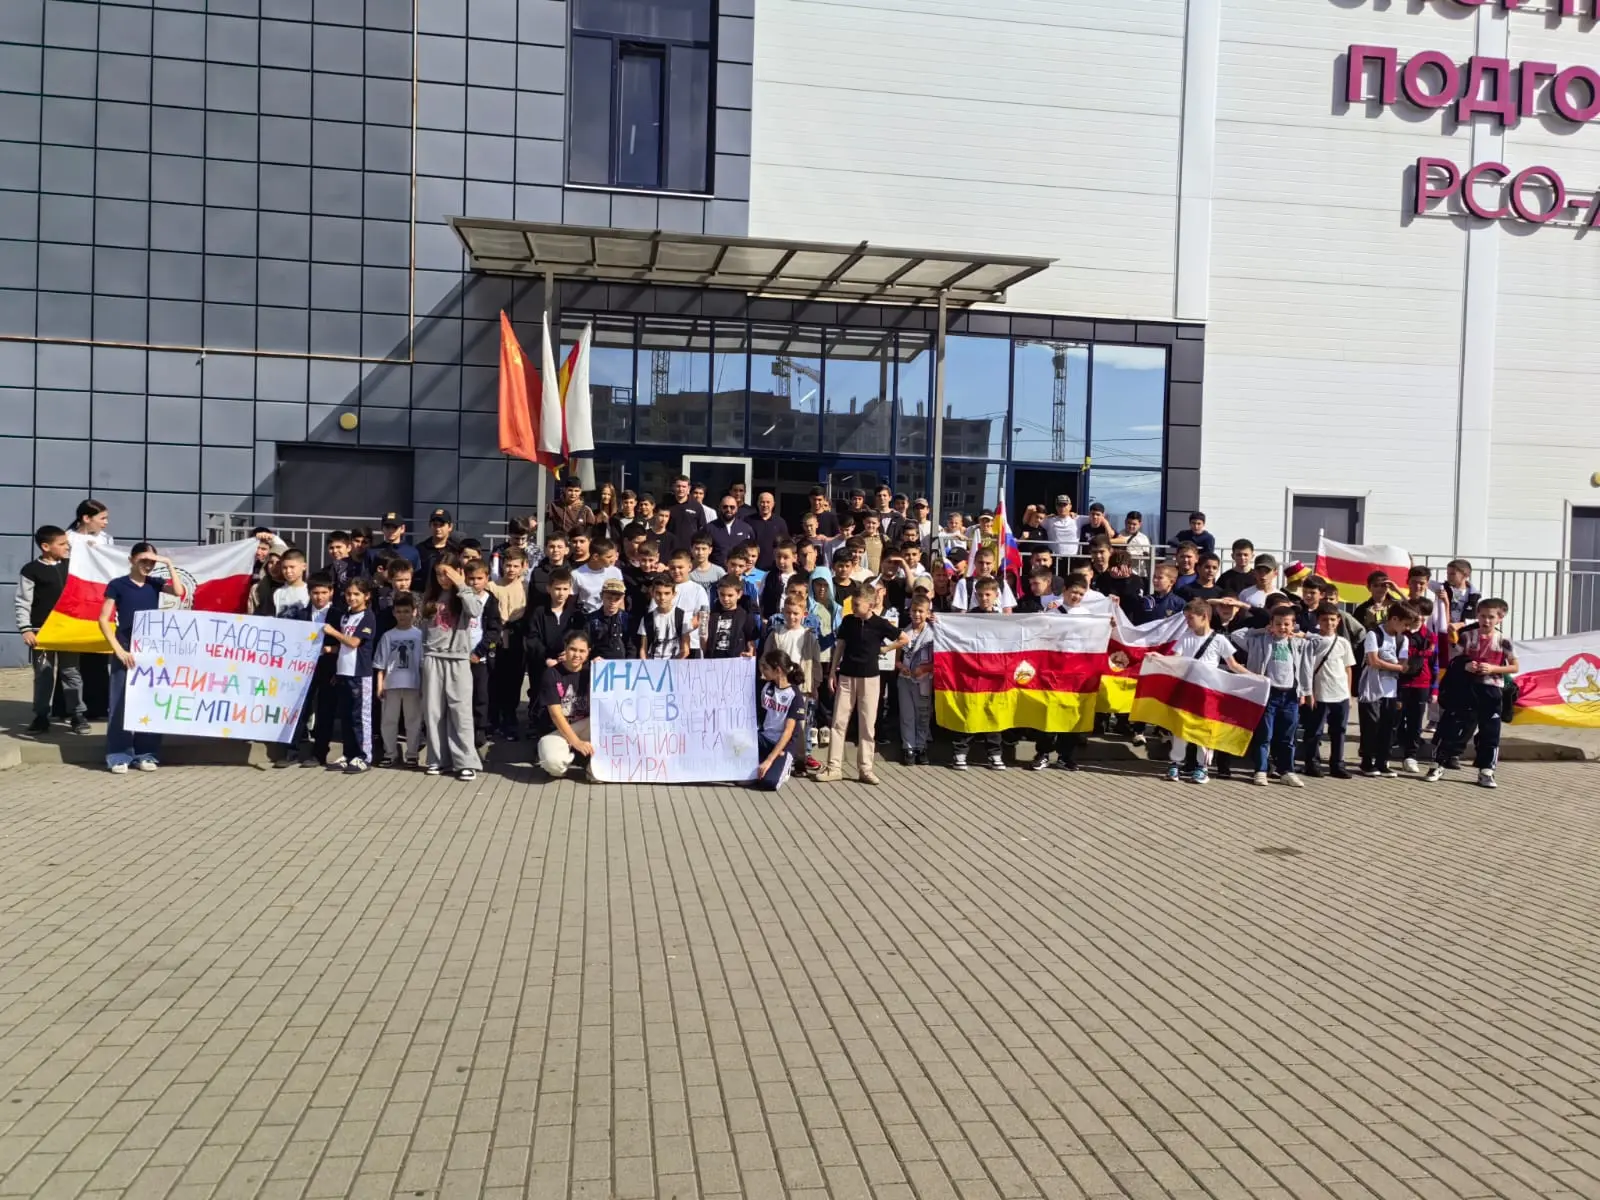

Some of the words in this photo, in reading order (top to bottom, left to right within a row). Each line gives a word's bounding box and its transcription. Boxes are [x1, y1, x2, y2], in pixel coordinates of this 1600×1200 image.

[1346, 44, 1600, 125] ПОДГО
[1416, 157, 1600, 230] РСО-
[133, 611, 200, 641] ИНАЛ
[210, 619, 287, 657] ТАСОЕВ
[205, 643, 284, 668] ЧЕМПИОН
[130, 666, 240, 696] МАДИНА
[592, 660, 674, 692] ИНАЛ
[599, 732, 686, 757] ЧЕМПИОН
[610, 757, 669, 781] МИРА
